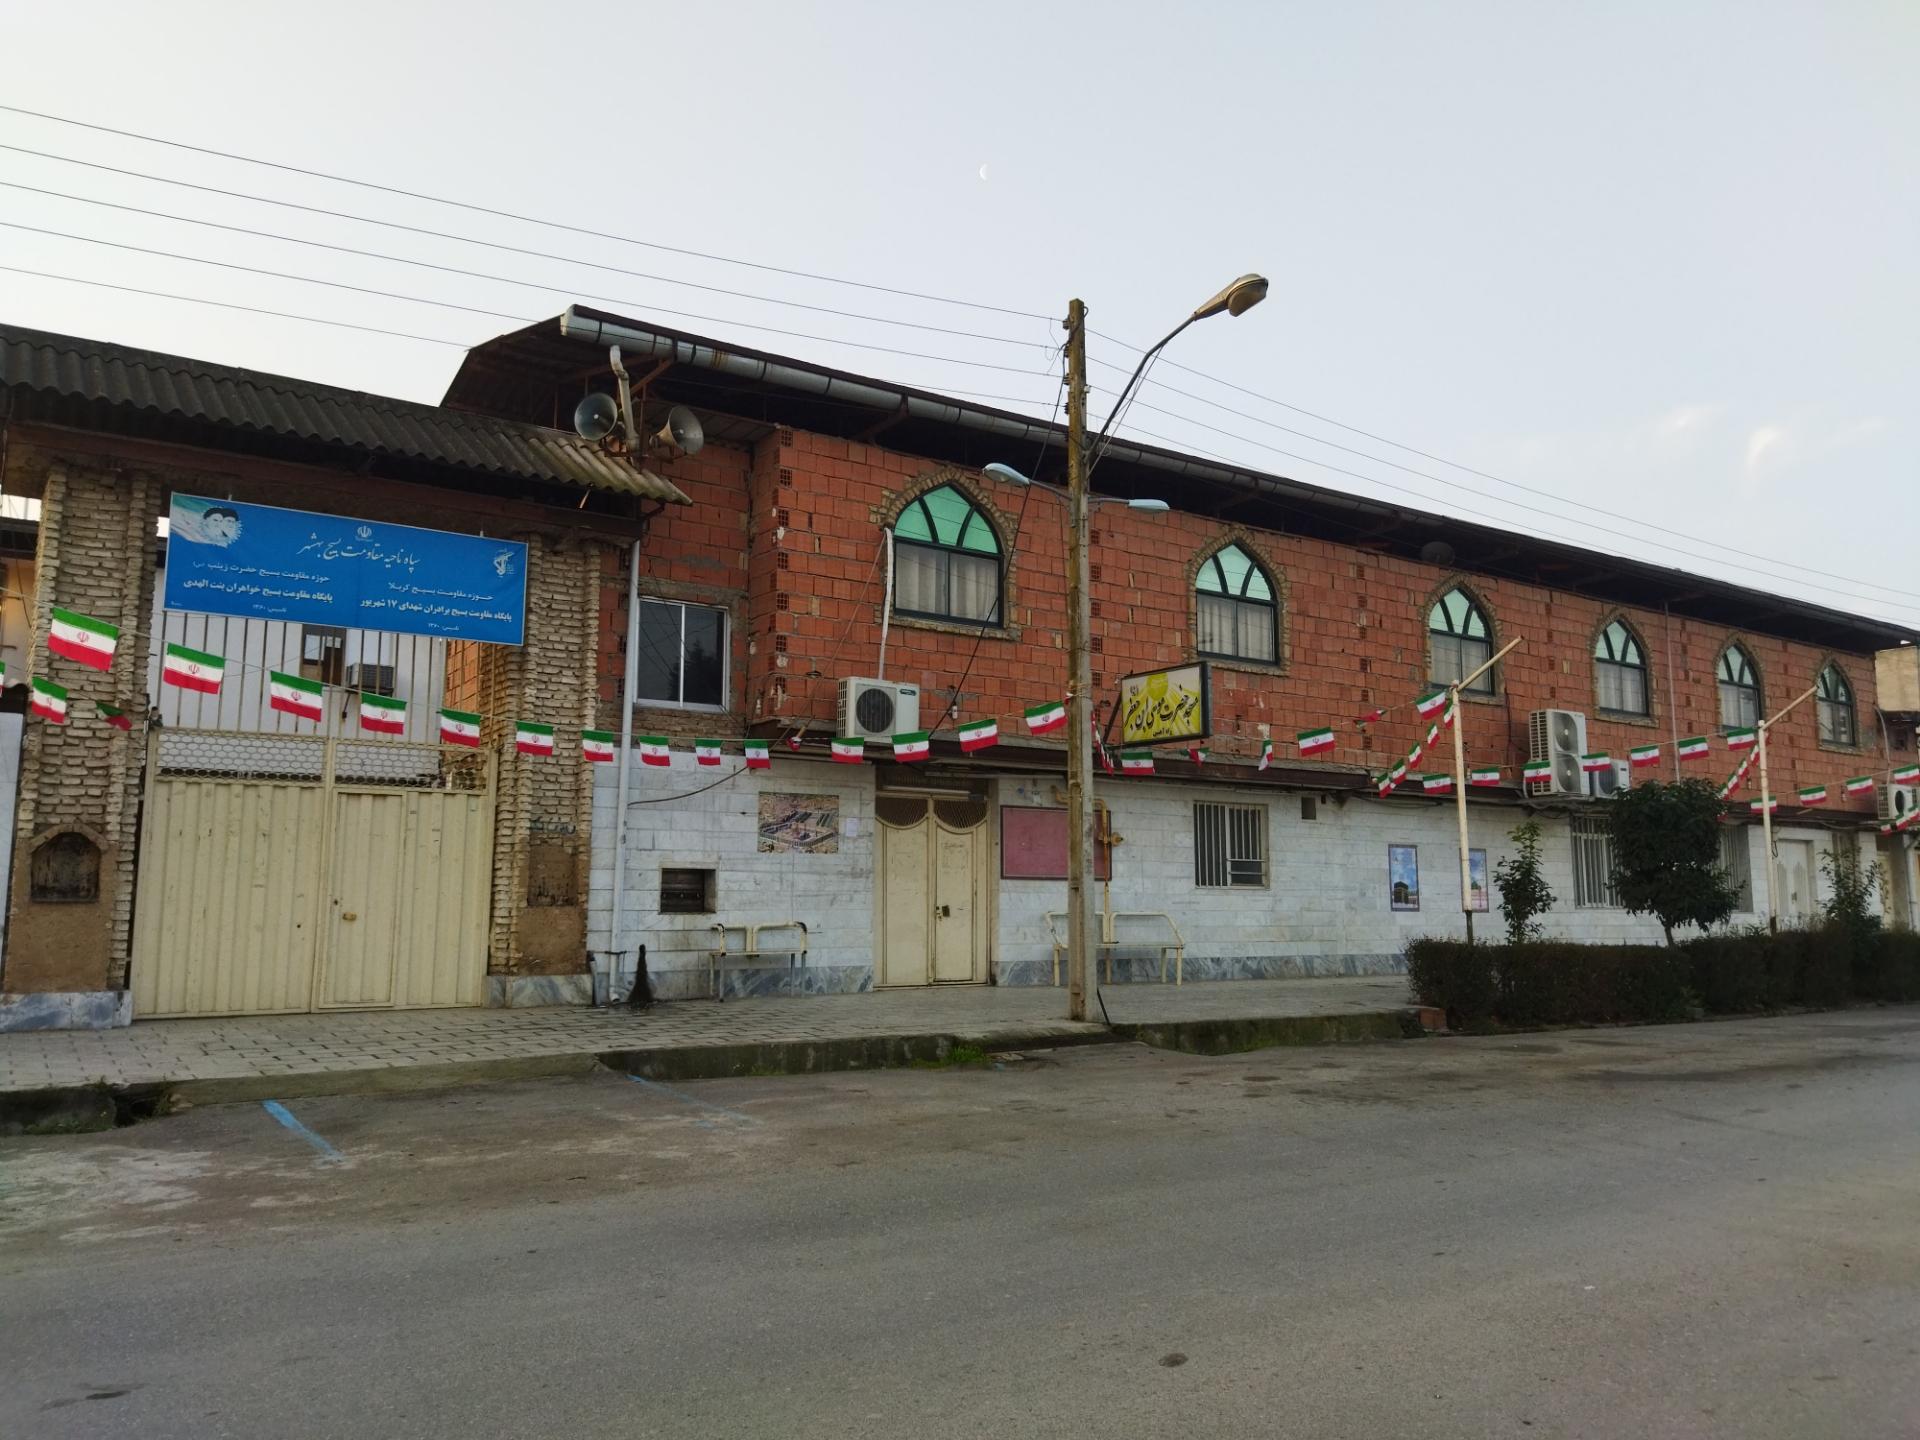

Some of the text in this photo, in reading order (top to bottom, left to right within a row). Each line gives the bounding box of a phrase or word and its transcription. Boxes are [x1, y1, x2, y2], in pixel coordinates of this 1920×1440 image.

[340, 543, 384, 561] مقاومت
[384, 548, 402, 568] ناحیه
[207, 560, 229, 573] زینب
[230, 564, 257, 575] حضرت
[258, 568, 281, 577] بسیج
[403, 553, 421, 574] سپاه
[281, 570, 310, 581] مقاومت
[311, 574, 330, 583] حوزه
[183, 578, 333, 603] پایگاه مقاومت بسیج خواهران بنت الهدی
[387, 581, 494, 602] حوزه مقاومت بسیج کربلا
[360, 599, 513, 624] پایگاه مقاومت بسیج برادران شهدای ۱۷ شهریور
